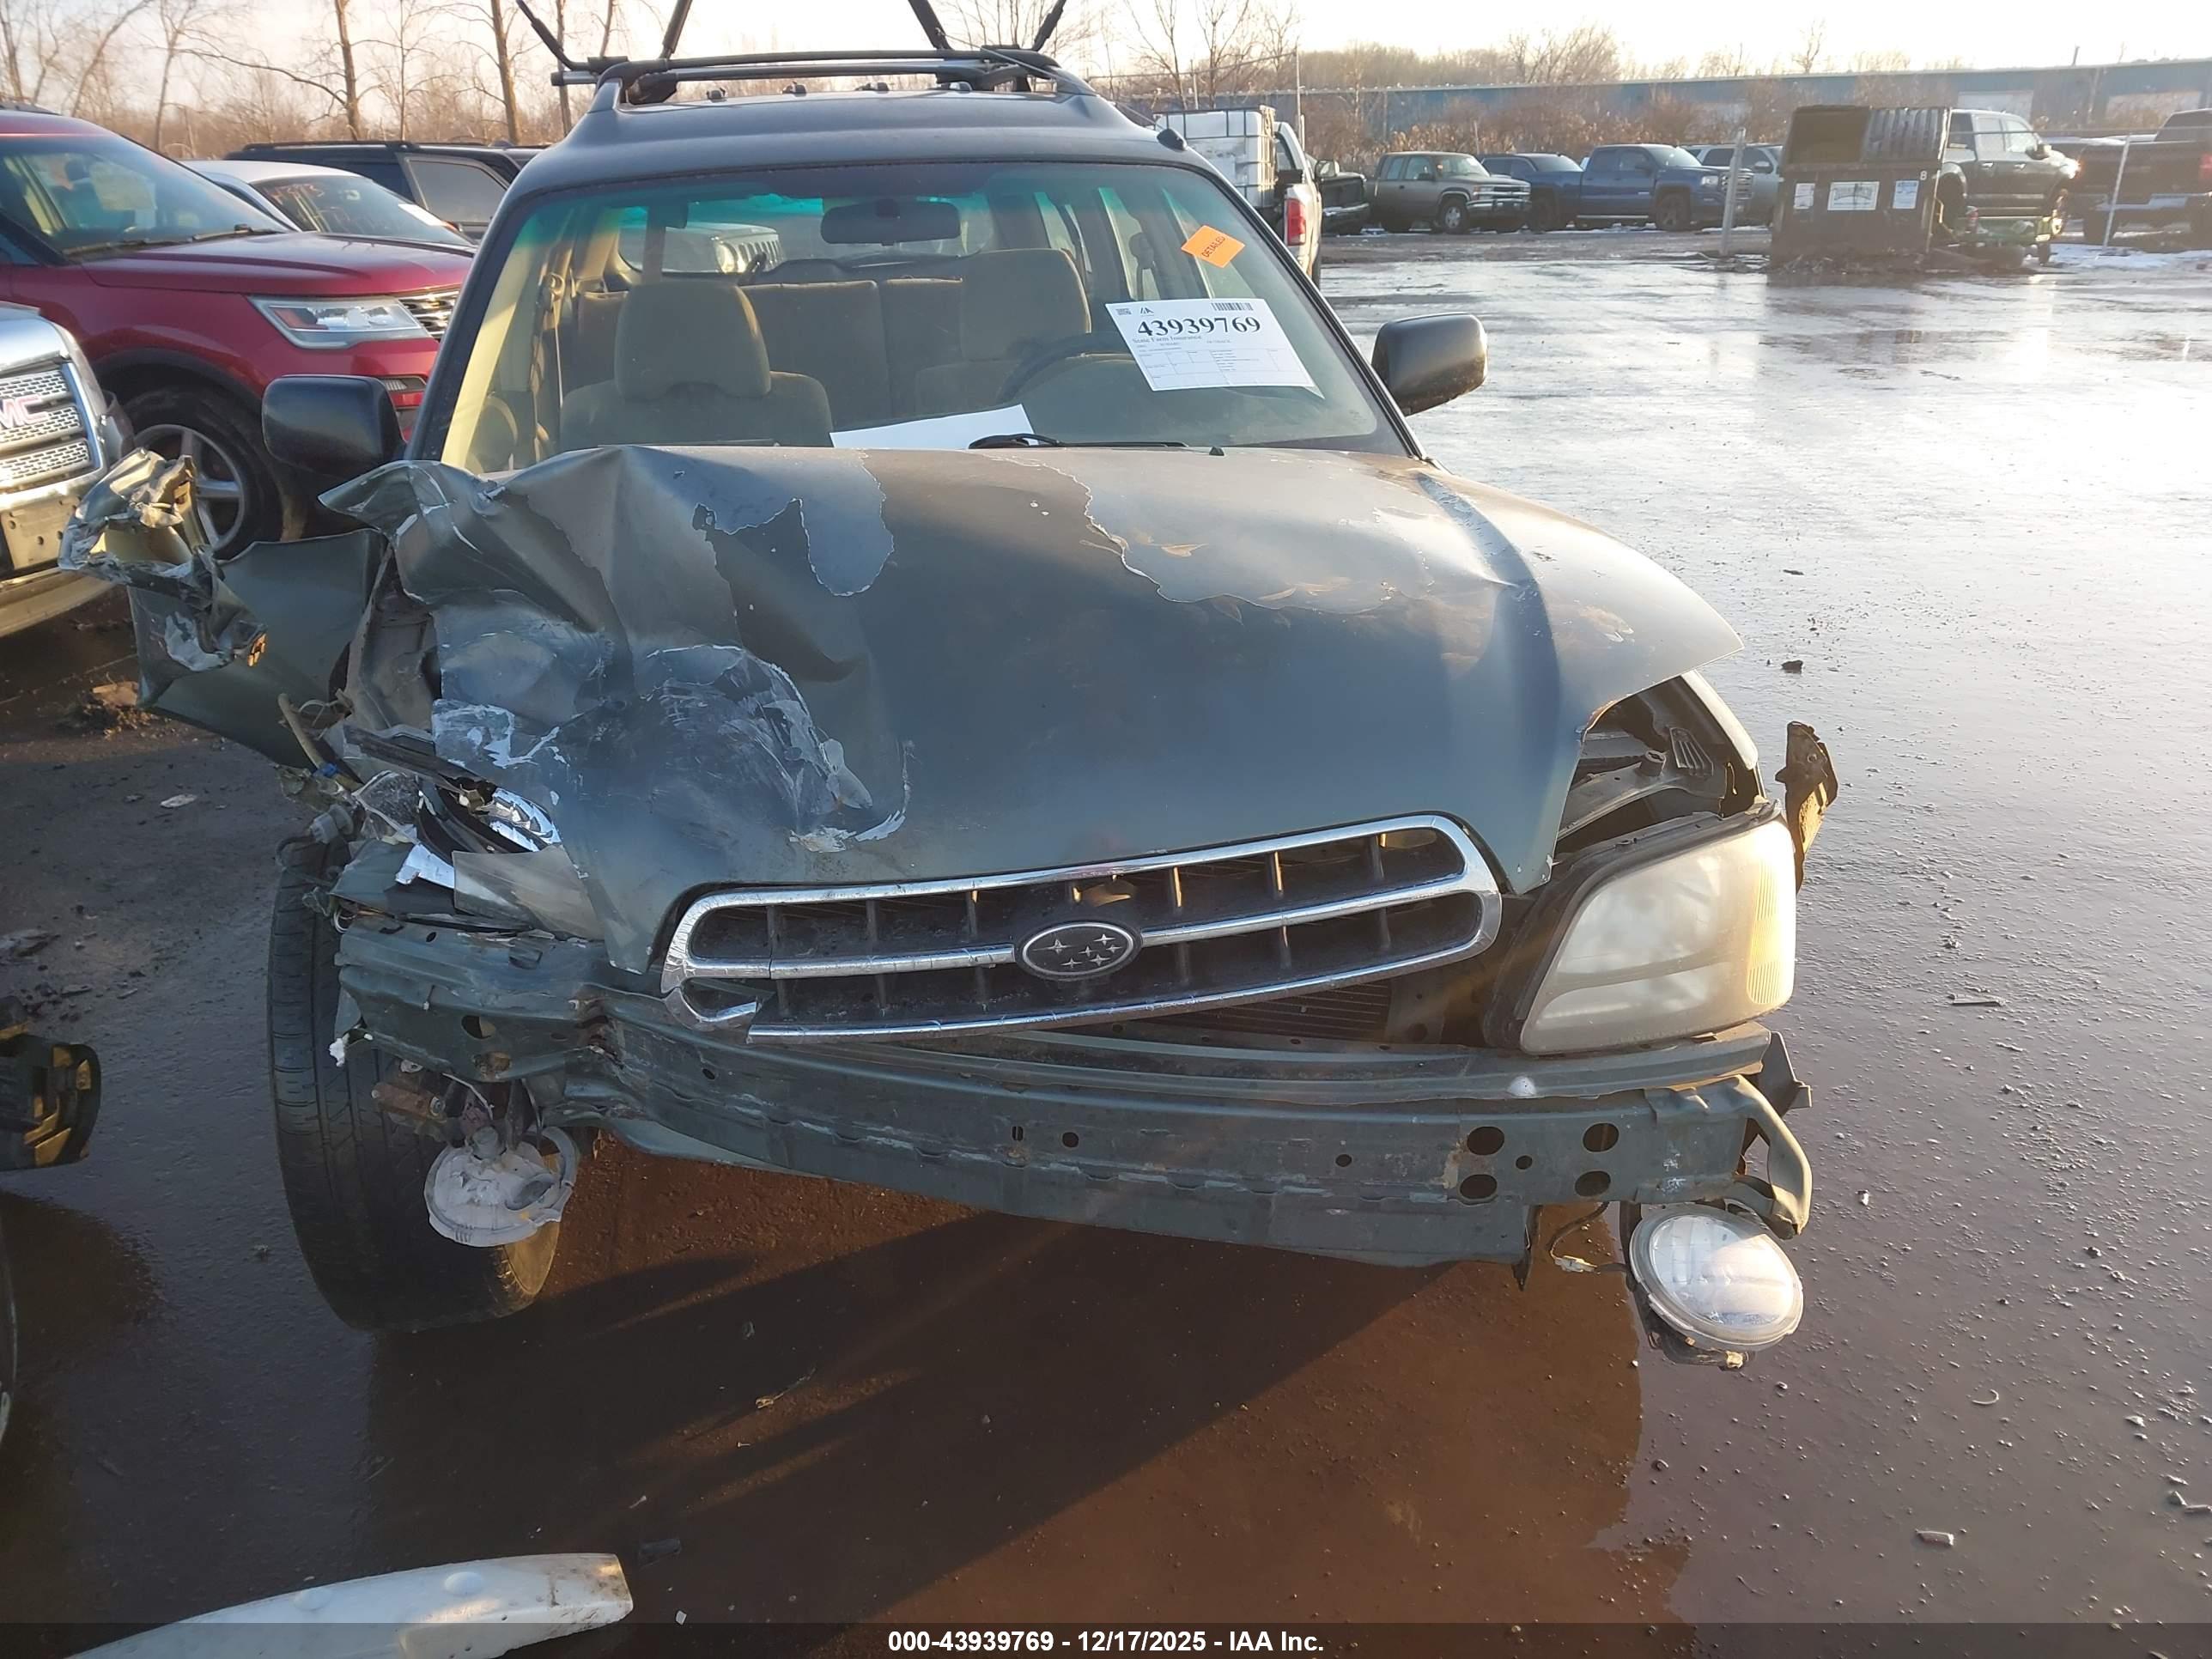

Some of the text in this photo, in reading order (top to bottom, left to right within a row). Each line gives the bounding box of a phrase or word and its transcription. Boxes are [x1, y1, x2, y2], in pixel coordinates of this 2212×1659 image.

[1201, 236, 1225, 258] DETAILED
[1138, 316, 1261, 337] 43939769
[0, 394, 49, 429] MC
